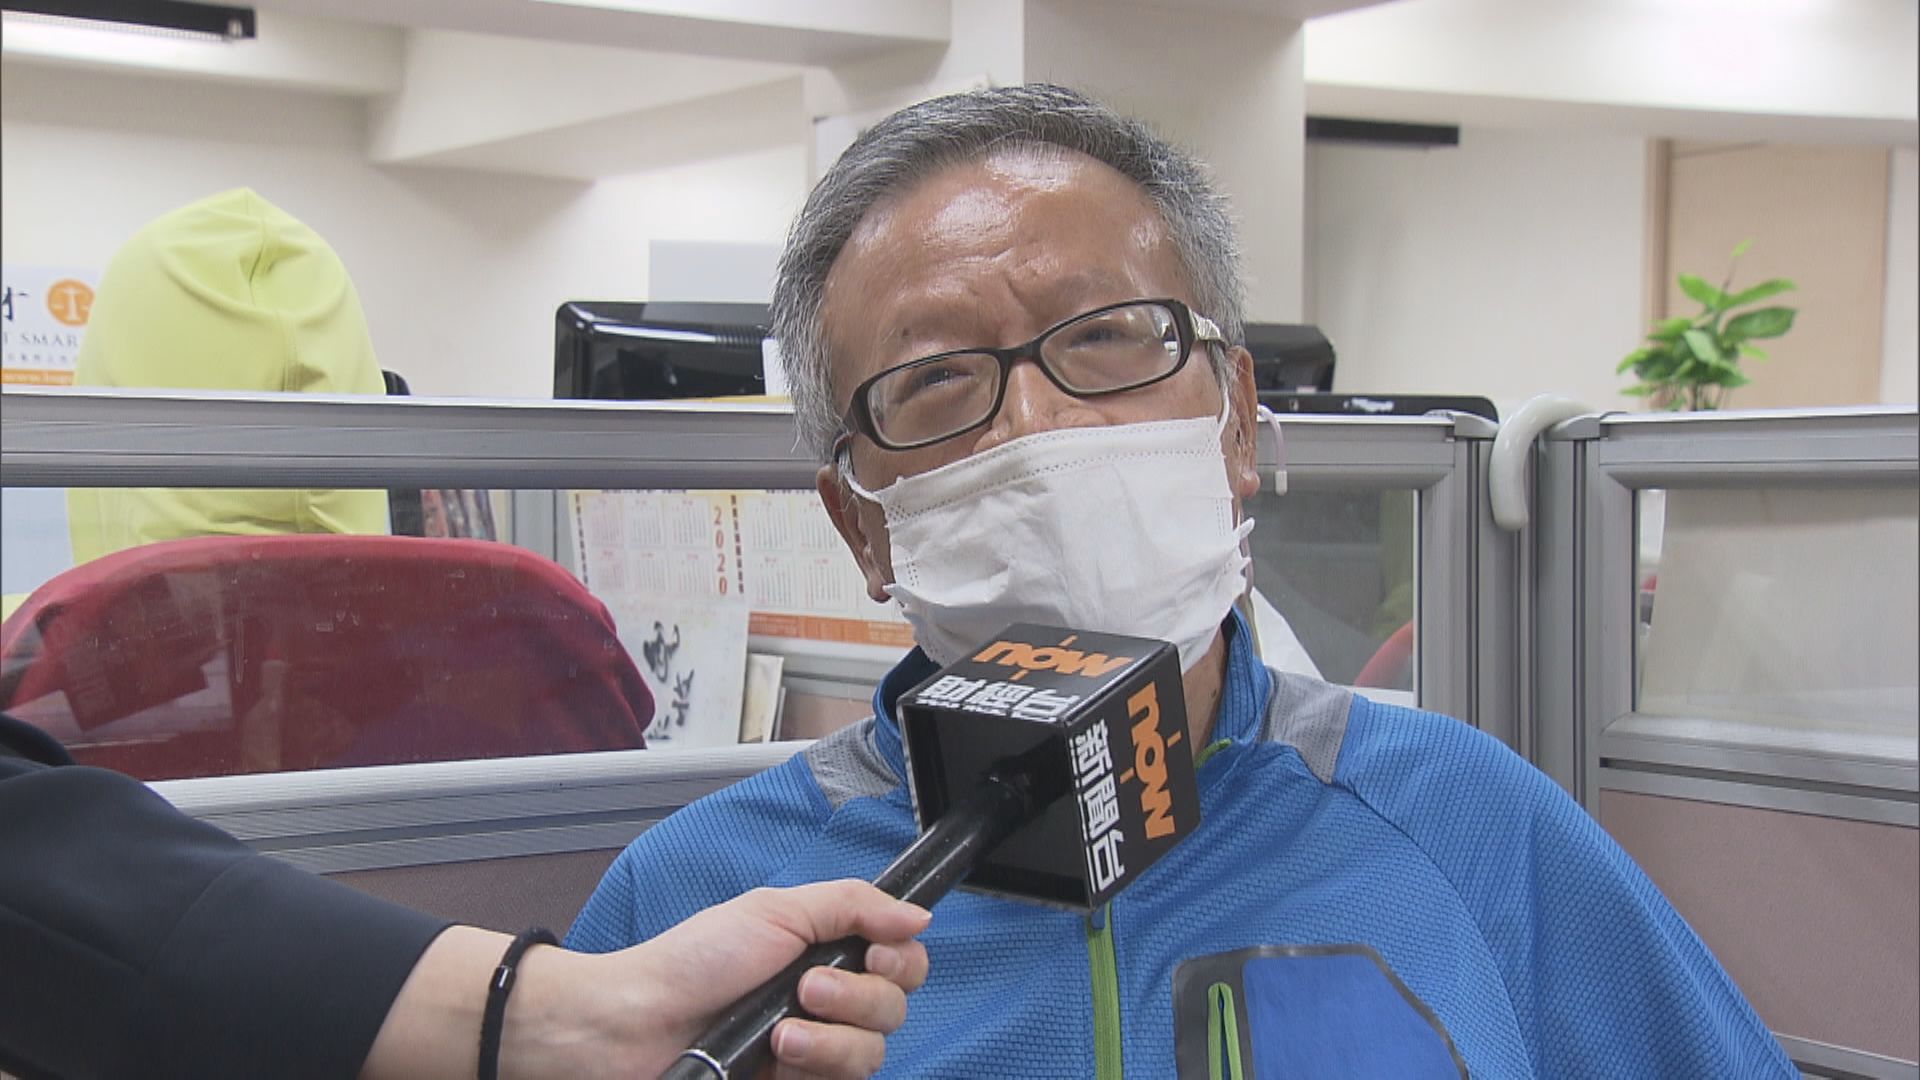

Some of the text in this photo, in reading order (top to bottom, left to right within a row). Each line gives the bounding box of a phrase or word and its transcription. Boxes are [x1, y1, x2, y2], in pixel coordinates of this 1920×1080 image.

[712, 506, 728, 596] 2020
[971, 635, 1134, 681] now
[1068, 718, 1125, 894] 新聞台
[1119, 681, 1182, 840] now
